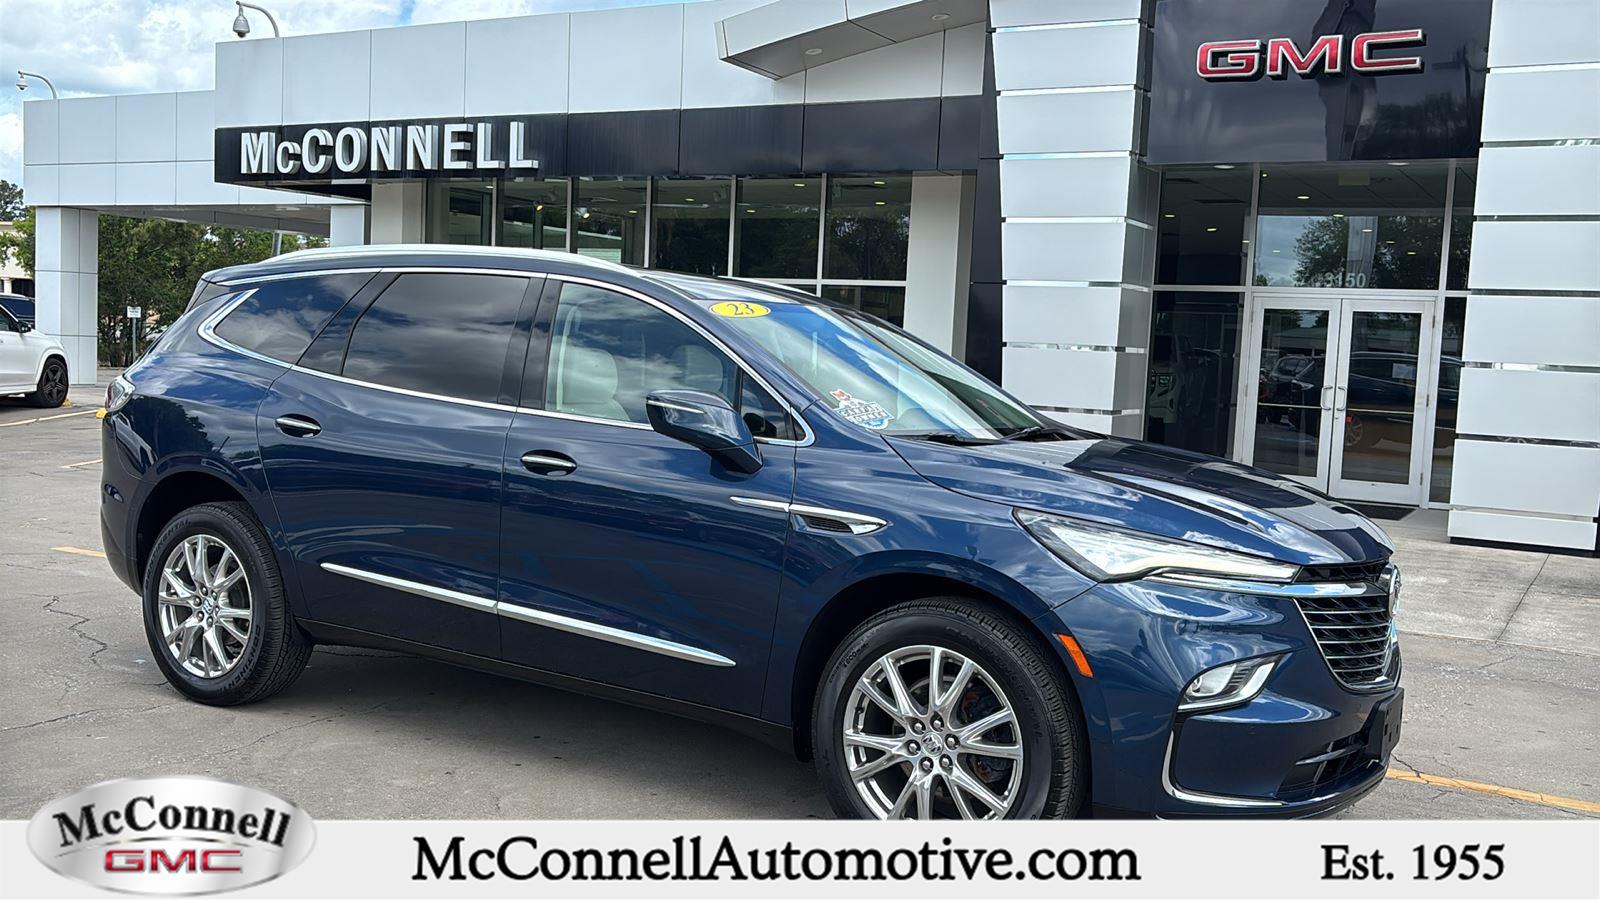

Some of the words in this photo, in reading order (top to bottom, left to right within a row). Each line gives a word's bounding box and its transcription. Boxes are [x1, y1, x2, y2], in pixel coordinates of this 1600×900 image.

[1196, 28, 1424, 80] GMC
[240, 121, 539, 175] McCONNELL
[1325, 271, 1367, 288] 3150
[726, 302, 755, 316] 23
